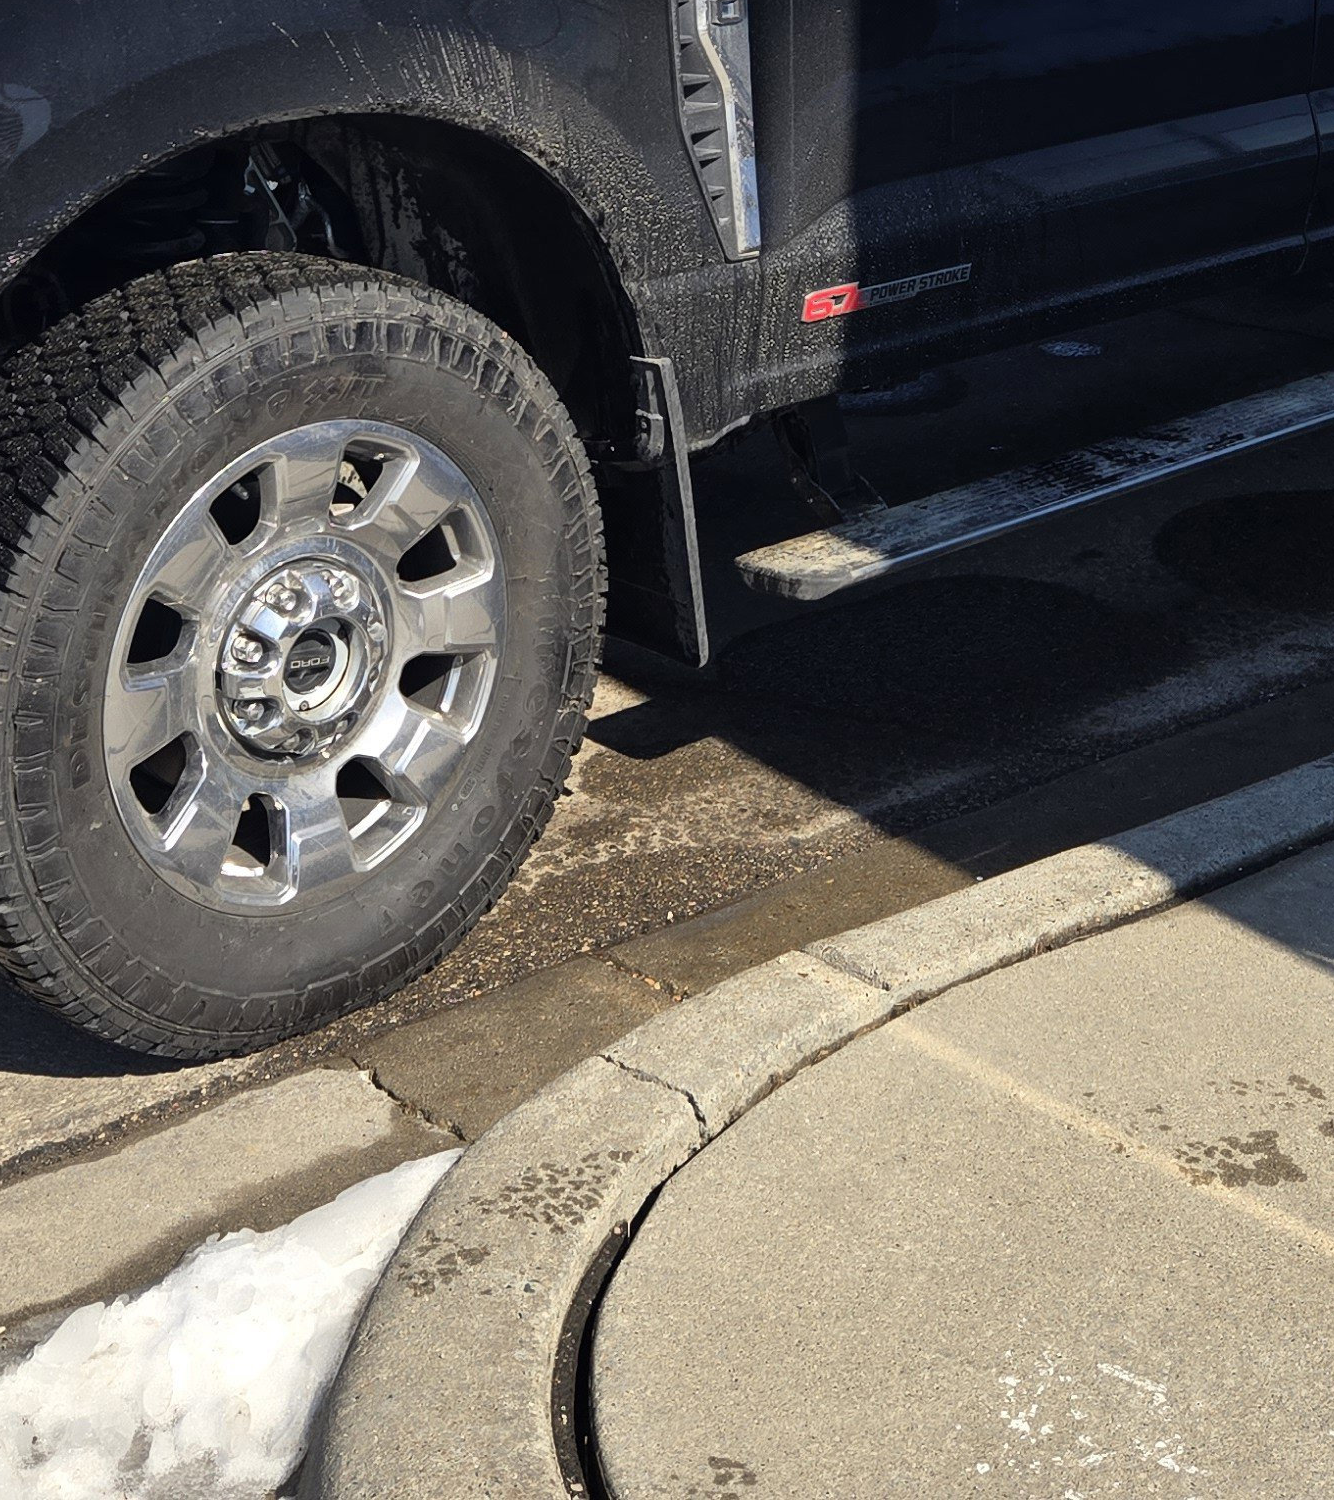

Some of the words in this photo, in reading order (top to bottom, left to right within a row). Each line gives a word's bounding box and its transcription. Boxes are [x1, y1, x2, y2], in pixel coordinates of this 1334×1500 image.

[870, 280, 917, 301] POWER
[918, 267, 968, 291] STROKE
[290, 655, 331, 669] FORD
